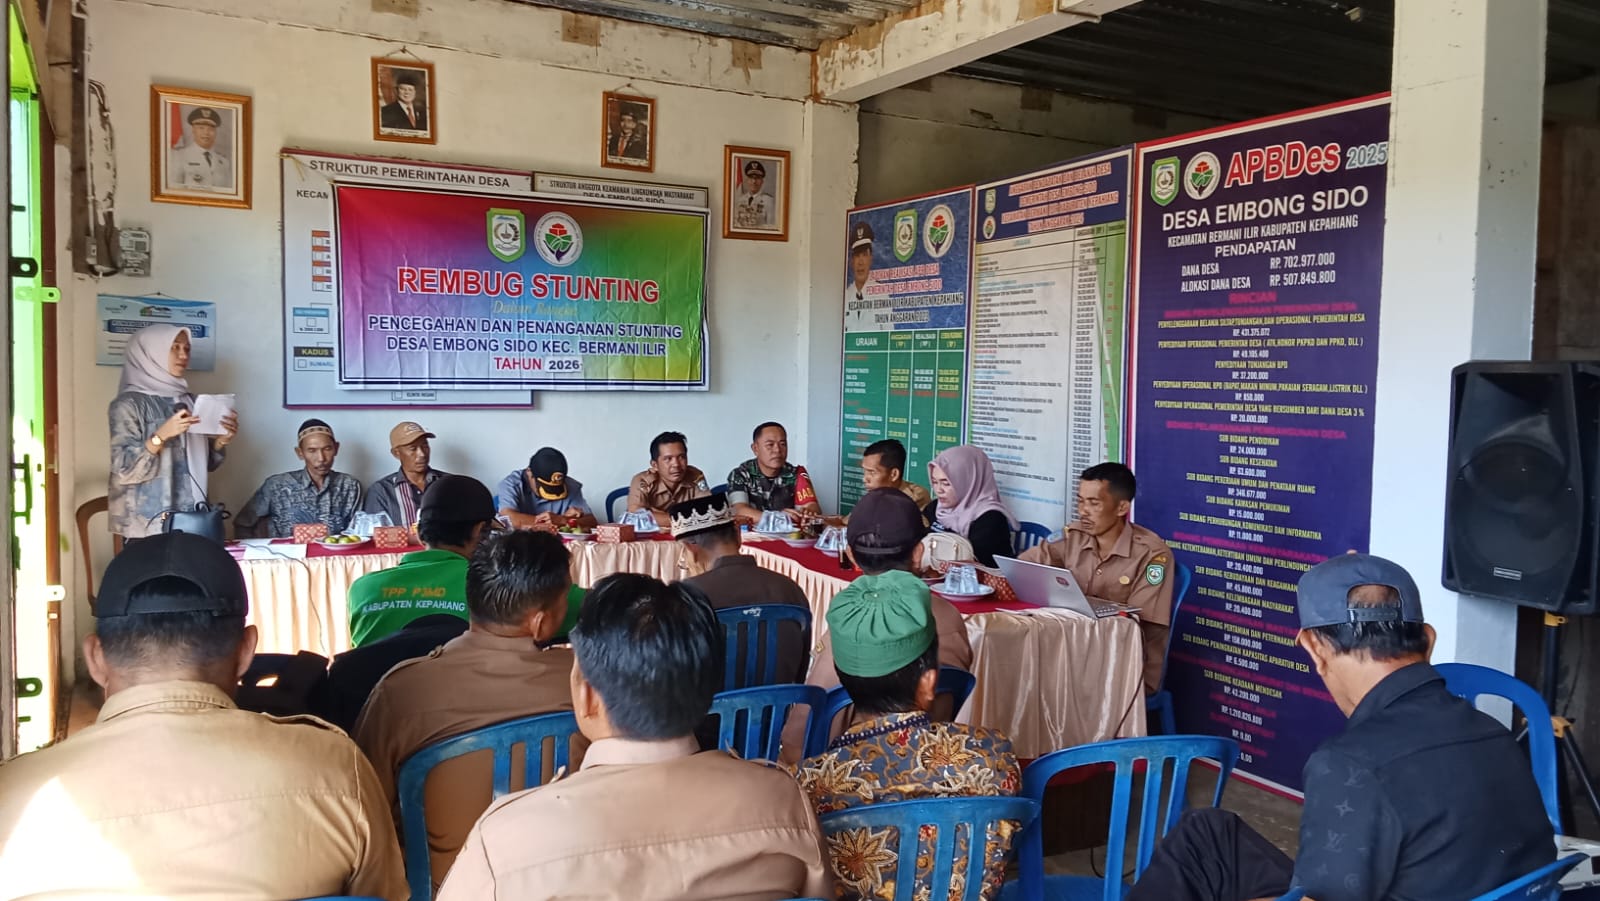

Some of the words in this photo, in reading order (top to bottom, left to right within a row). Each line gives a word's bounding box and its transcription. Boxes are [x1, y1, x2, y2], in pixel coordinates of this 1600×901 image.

[309, 160, 378, 176] STRUKTUR
[382, 167, 476, 185] PEMERINTAHAN
[478, 176, 510, 188] DESA
[1224, 140, 1340, 188] APBDes
[1346, 142, 1388, 169] 2025
[549, 180, 577, 190] STRUKTUR
[577, 182, 601, 191] ANGGOTA
[602, 185, 630, 195] KEAMANAN
[1162, 207, 1211, 231] DESA
[1215, 194, 1305, 225] EMBONG
[1311, 185, 1369, 213] SIDO
[1168, 231, 1207, 248] KECAMATAN
[1208, 228, 1242, 244] BERMANI
[1243, 225, 1259, 239] ILIR
[1261, 219, 1307, 238] KABUPATEN
[1309, 214, 1359, 232] KEPAHIANG
[1215, 238, 1296, 258] PENDAPATAN
[1181, 264, 1200, 277] DANA
[1201, 262, 1220, 275] DESA
[1270, 256, 1281, 270] RP.
[1283, 252, 1335, 268] 702.977.000
[398, 266, 523, 297] REMBUG
[530, 273, 660, 304] STUNTING
[1181, 279, 1209, 293] ALOKASI
[1211, 277, 1230, 291] DANA
[1231, 276, 1251, 289] DESA
[1270, 274, 1281, 287] RP.
[1283, 270, 1336, 286] 507.849.800
[368, 315, 477, 333] PENCEGAHAN
[481, 318, 512, 334] DAN
[516, 319, 614, 336] PENANGANAN
[617, 323, 683, 339] STUNTING
[387, 336, 429, 351] DESA
[433, 336, 499, 353] EMBONG
[503, 338, 539, 354] SIDO
[542, 340, 575, 354] KEC.
[578, 341, 641, 356] BERMANI
[642, 342, 667, 356] ILIR
[493, 356, 542, 370] TAHUN
[548, 359, 580, 371] 2026
[1297, 484, 1316, 495] RUANG
[1285, 526, 1322, 541] INFORMATIKA
[362, 600, 411, 614] KABUPATEN
[415, 600, 466, 612] KEPAHIANG
[1295, 660, 1310, 674] DESA
